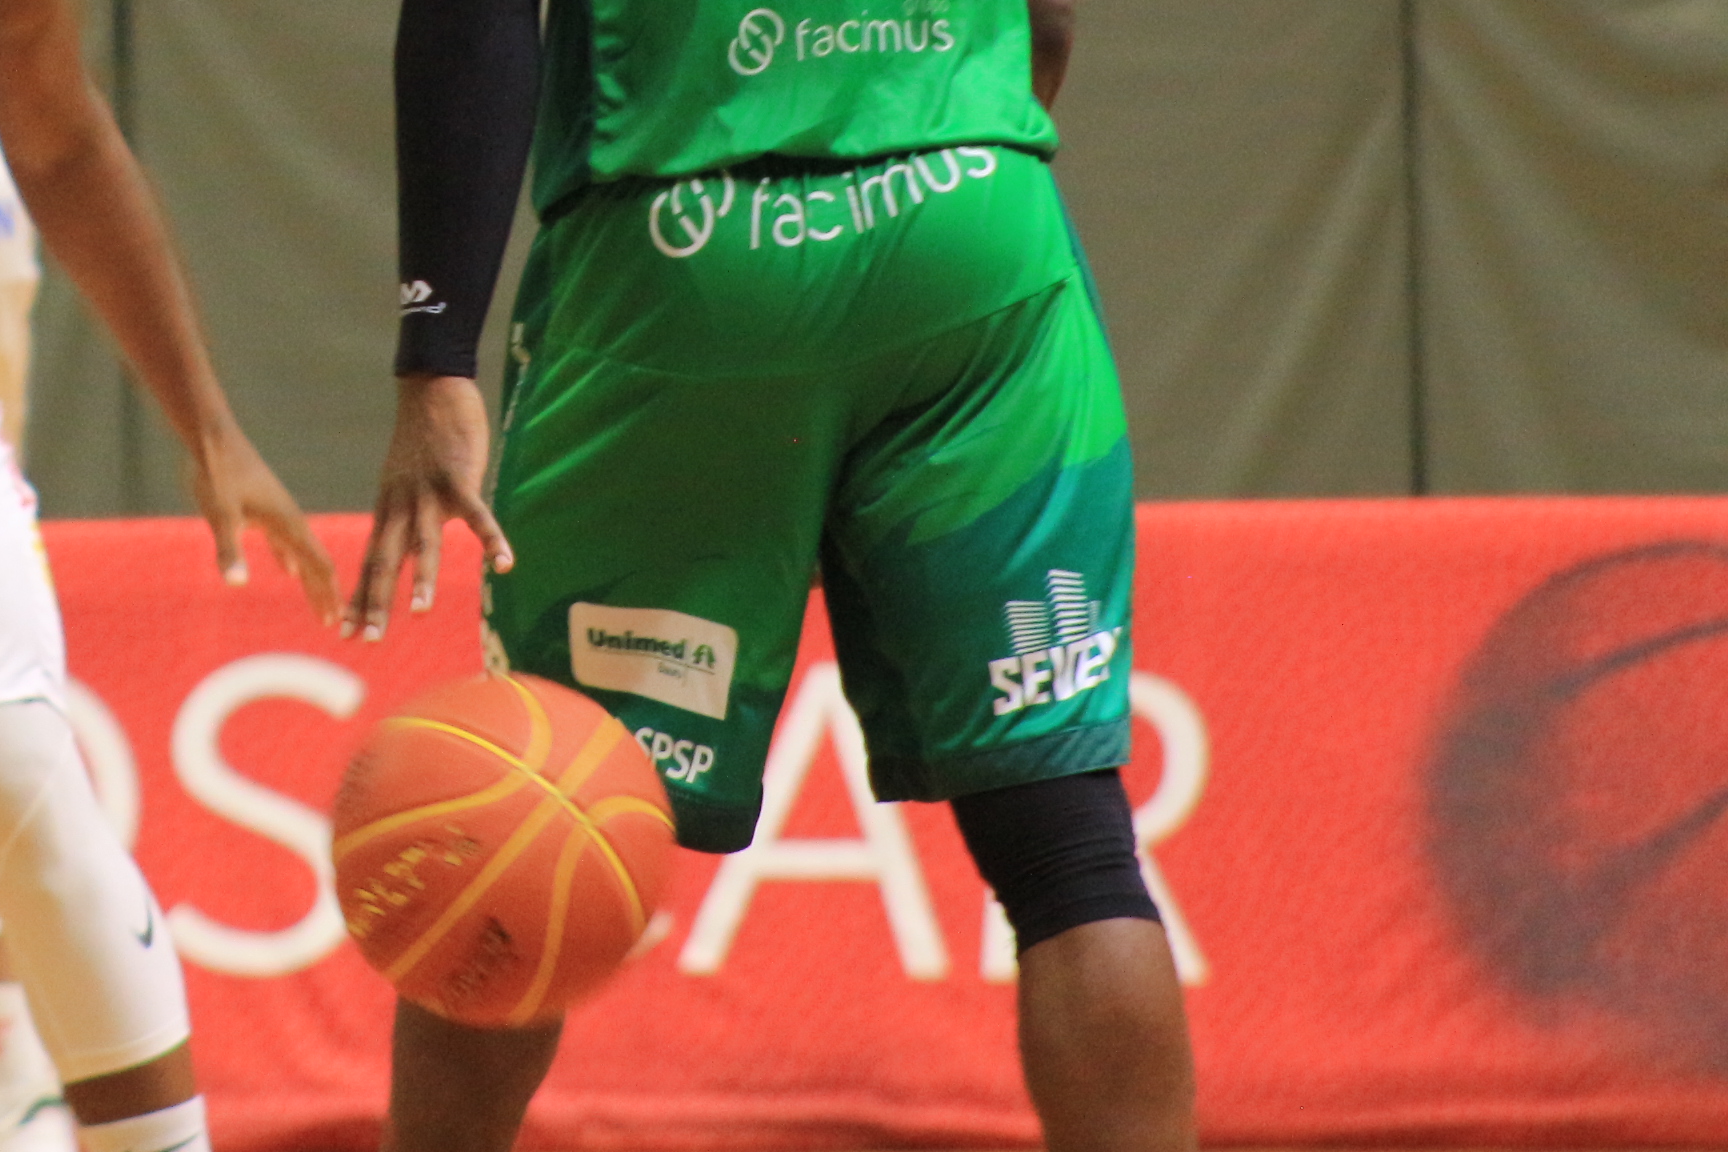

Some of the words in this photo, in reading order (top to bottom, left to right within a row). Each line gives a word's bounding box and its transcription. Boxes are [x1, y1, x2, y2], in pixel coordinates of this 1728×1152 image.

[795, 9, 956, 62] facimus
[748, 145, 998, 250] facimus
[586, 628, 688, 661] Unimed
